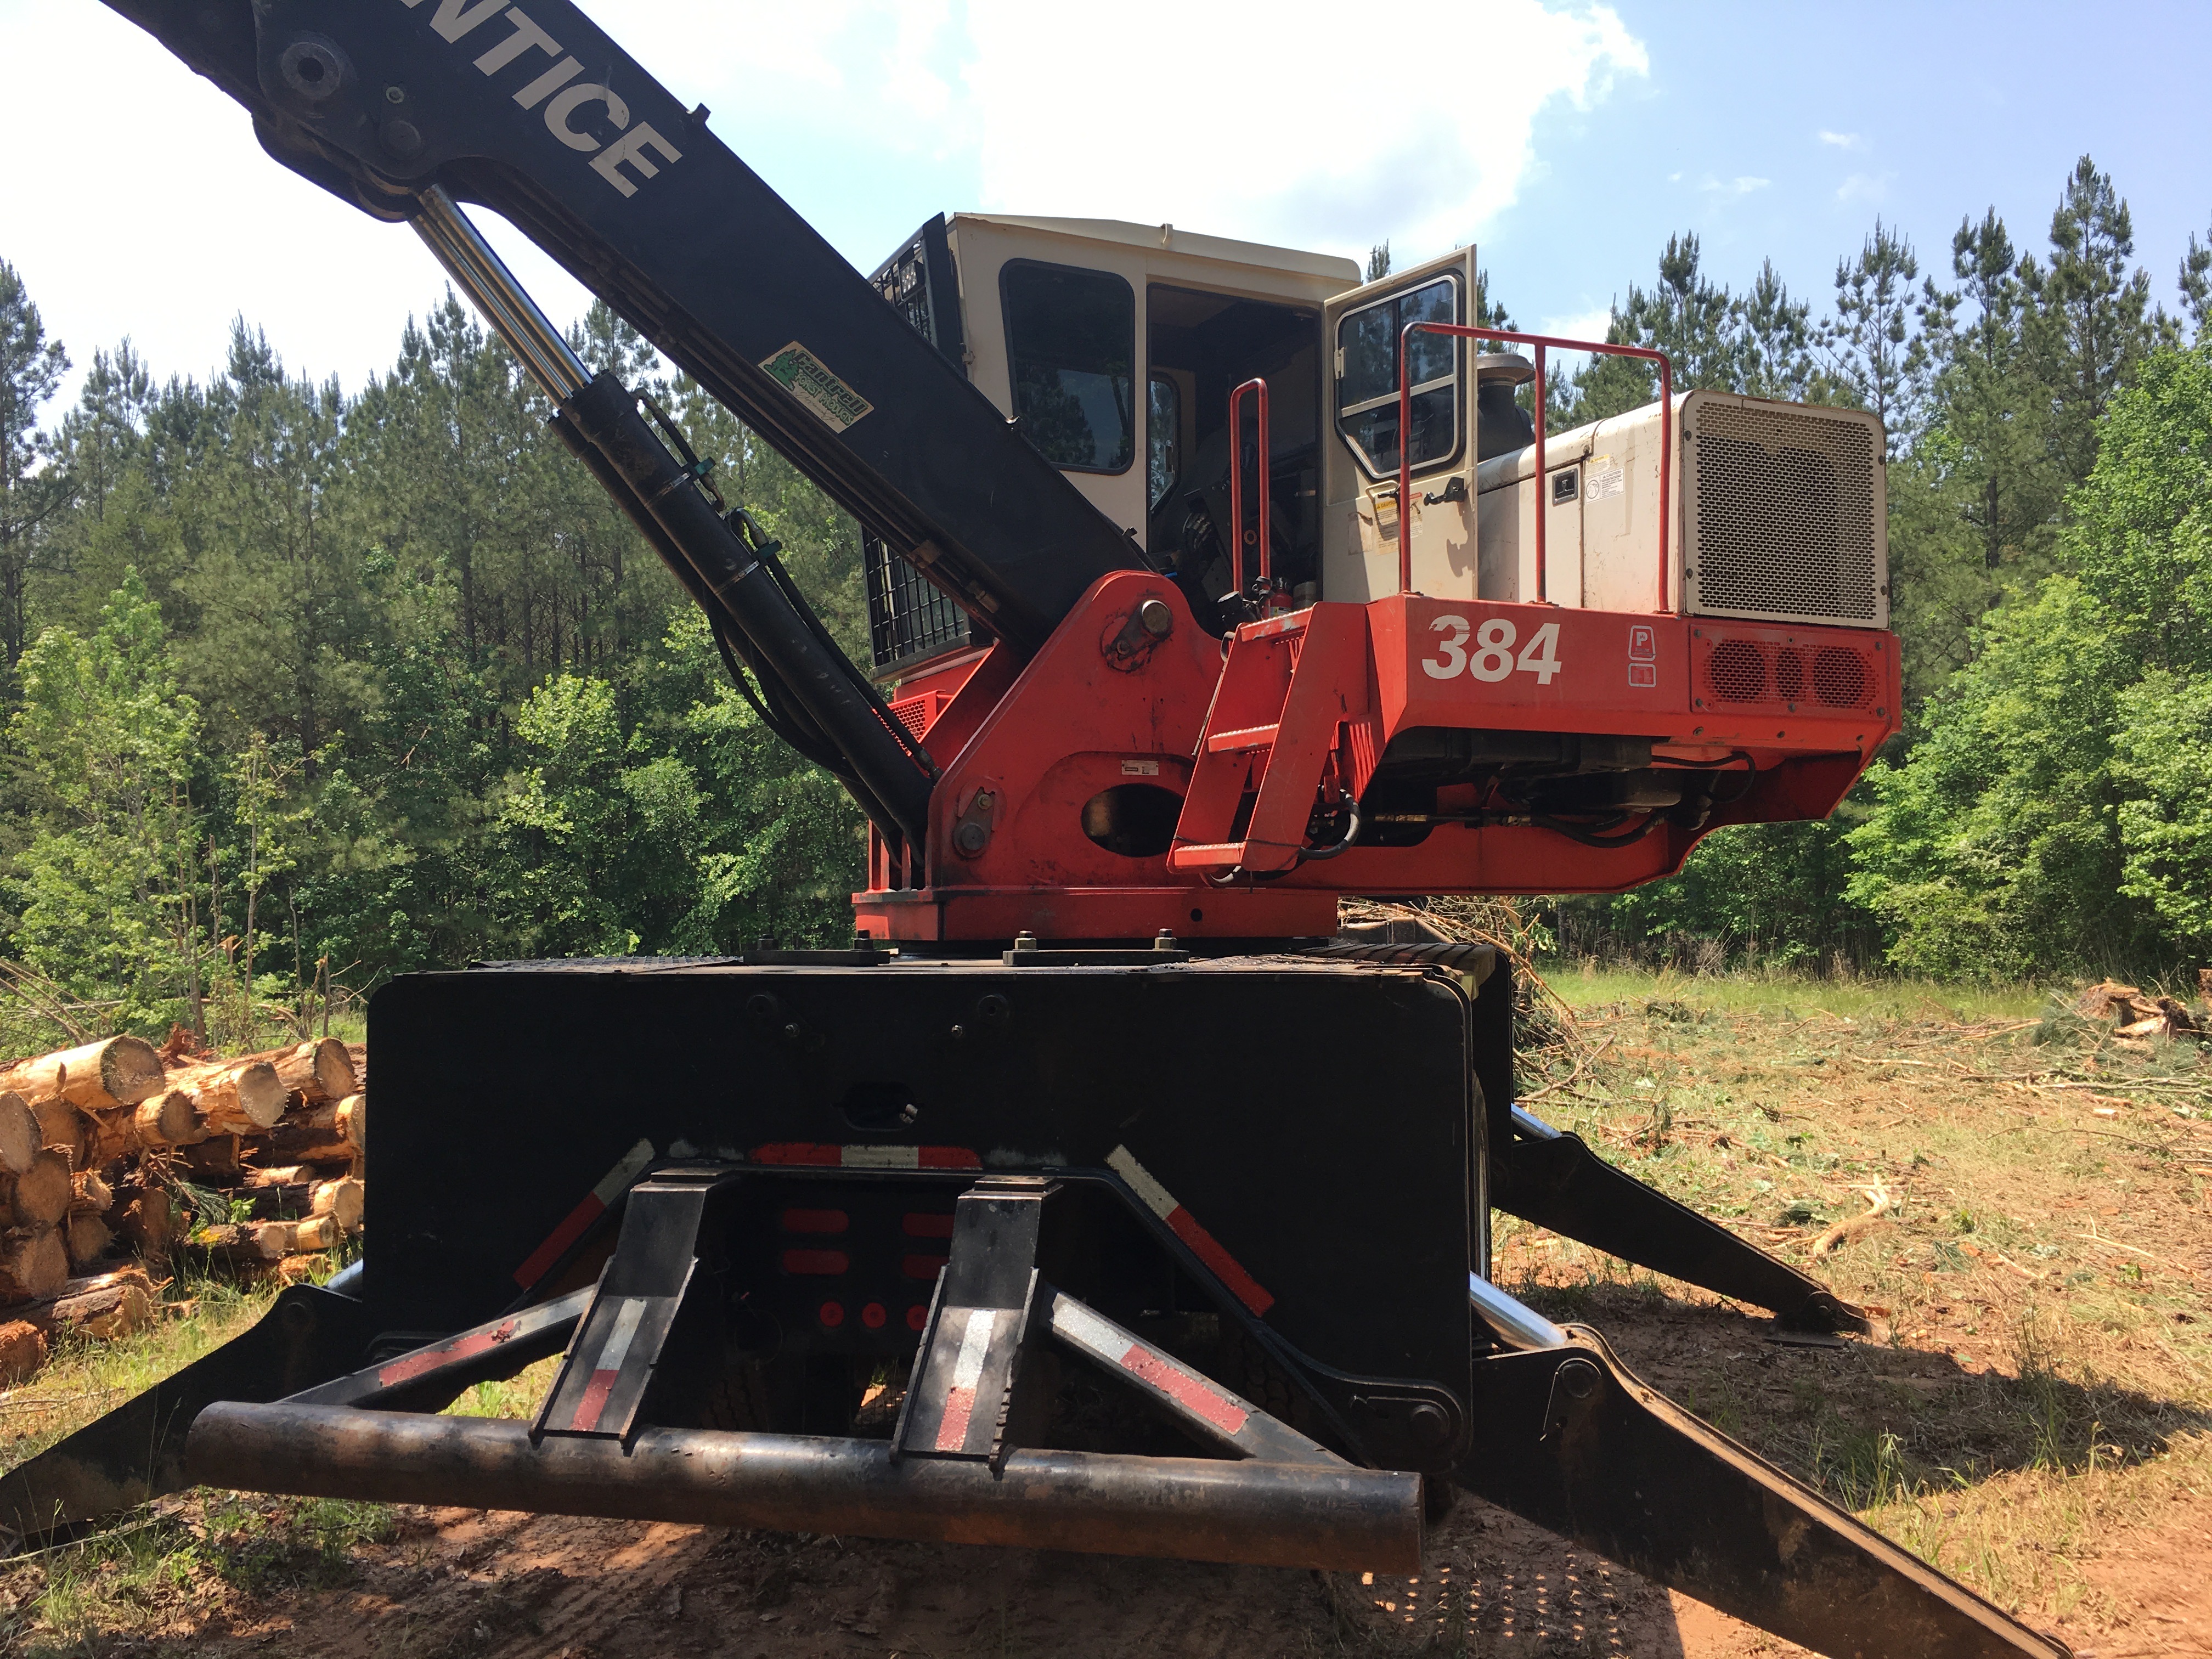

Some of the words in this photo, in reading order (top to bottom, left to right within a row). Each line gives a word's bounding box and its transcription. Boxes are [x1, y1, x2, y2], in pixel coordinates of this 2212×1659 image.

[793, 351, 867, 416] Cantrell
[795, 374, 822, 398] FOREST
[819, 392, 854, 426] PRODUCTS
[1421, 614, 1562, 685] 384
[1637, 631, 1648, 646] P
